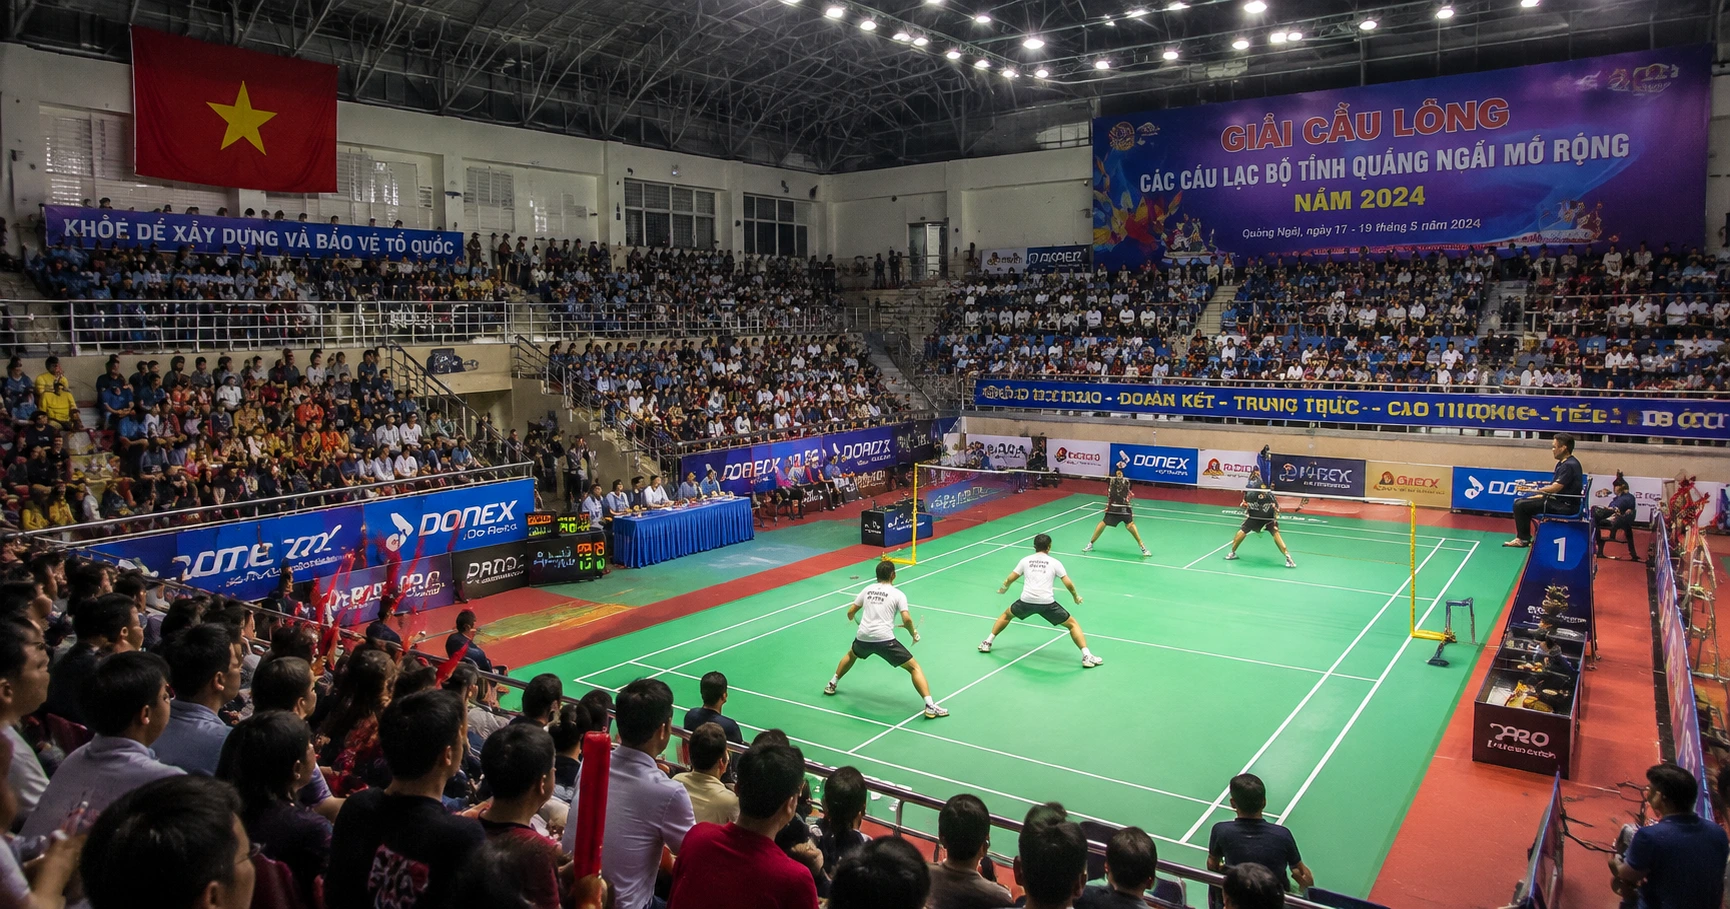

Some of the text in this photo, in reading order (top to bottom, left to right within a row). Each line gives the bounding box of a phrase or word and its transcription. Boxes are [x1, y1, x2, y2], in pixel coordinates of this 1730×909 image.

[1223, 164, 1259, 190] LẠC
[1360, 185, 1426, 209] 2024
[1334, 224, 1348, 234] 17
[1359, 223, 1372, 233] 19
[1450, 218, 1482, 230] 2024
[1133, 453, 1190, 470] DONEX
[418, 499, 518, 537] DONEX
[1553, 537, 1566, 562] 1
